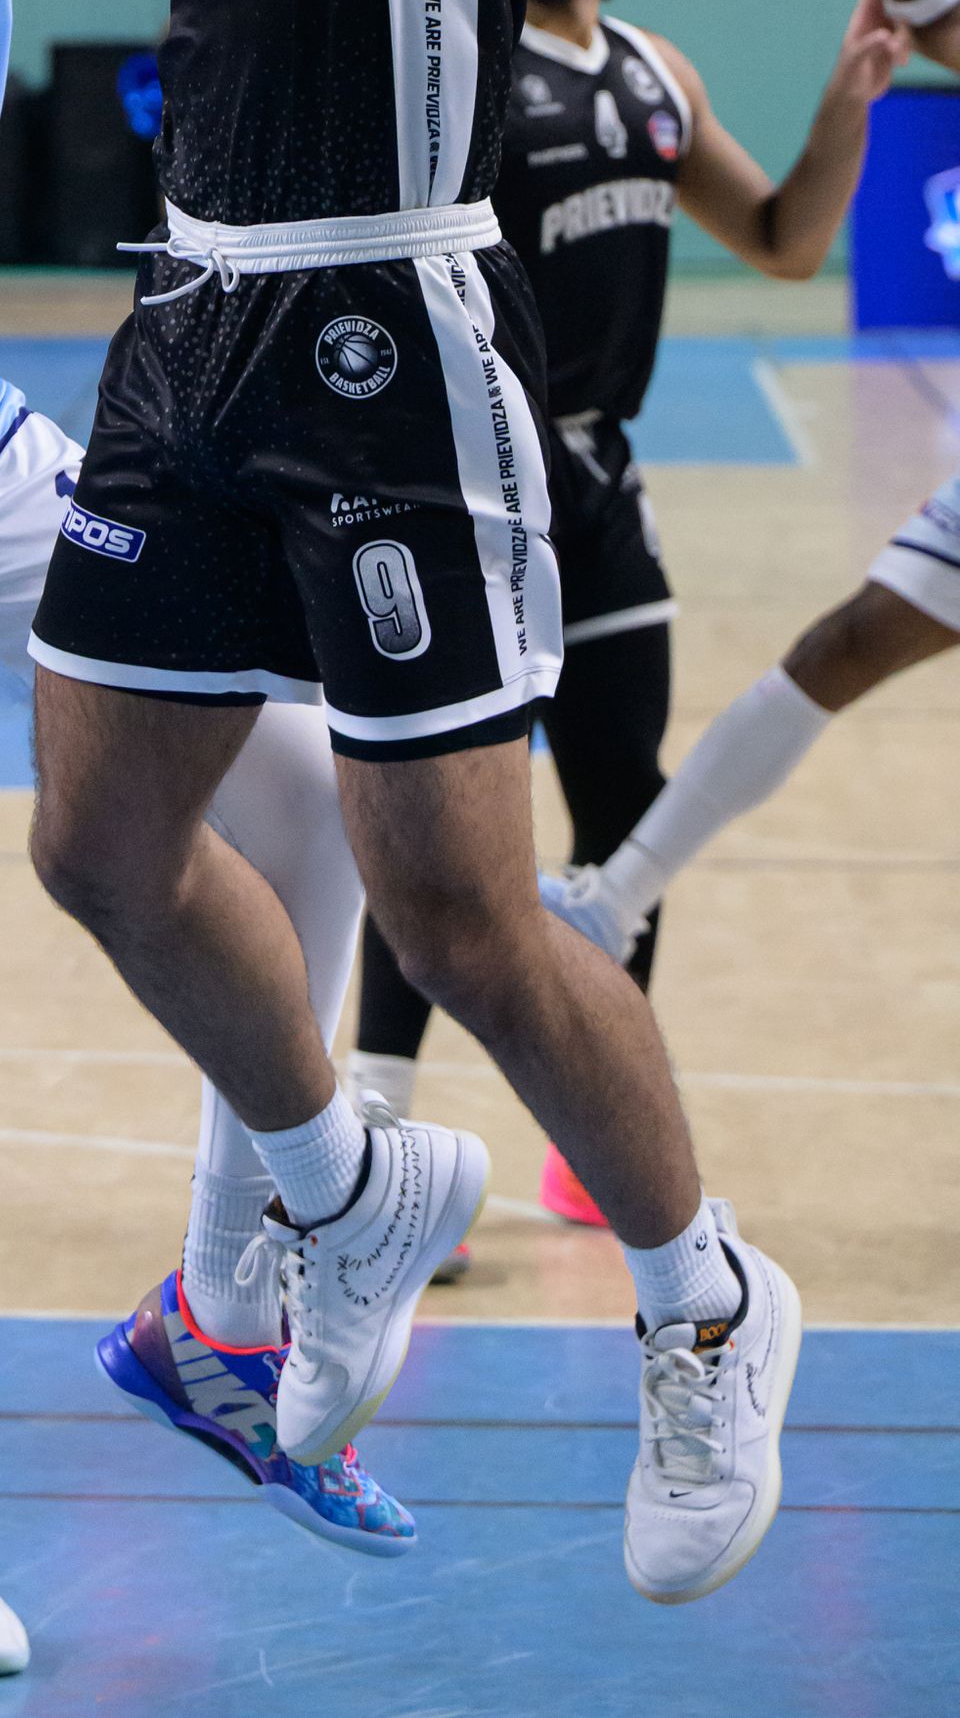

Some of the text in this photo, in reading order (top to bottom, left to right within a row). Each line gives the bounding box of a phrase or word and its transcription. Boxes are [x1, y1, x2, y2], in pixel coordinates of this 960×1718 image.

[425, 16, 442, 51] ARE
[426, 55, 441, 140] PRIEVIDZA
[541, 177, 674, 255] PRIEVIDZ
[323, 320, 380, 345] PRIEVIDZA
[329, 366, 391, 394] BASKETBALL
[482, 356, 499, 386] WE
[490, 398, 516, 479] PRIEVIDZA
[502, 482, 522, 513] ARE
[63, 508, 134, 554] IPOS
[352, 539, 432, 661] 9
[513, 594, 525, 625] ARE
[517, 627, 528, 656] WE
[163, 1311, 278, 1444] NIKE
